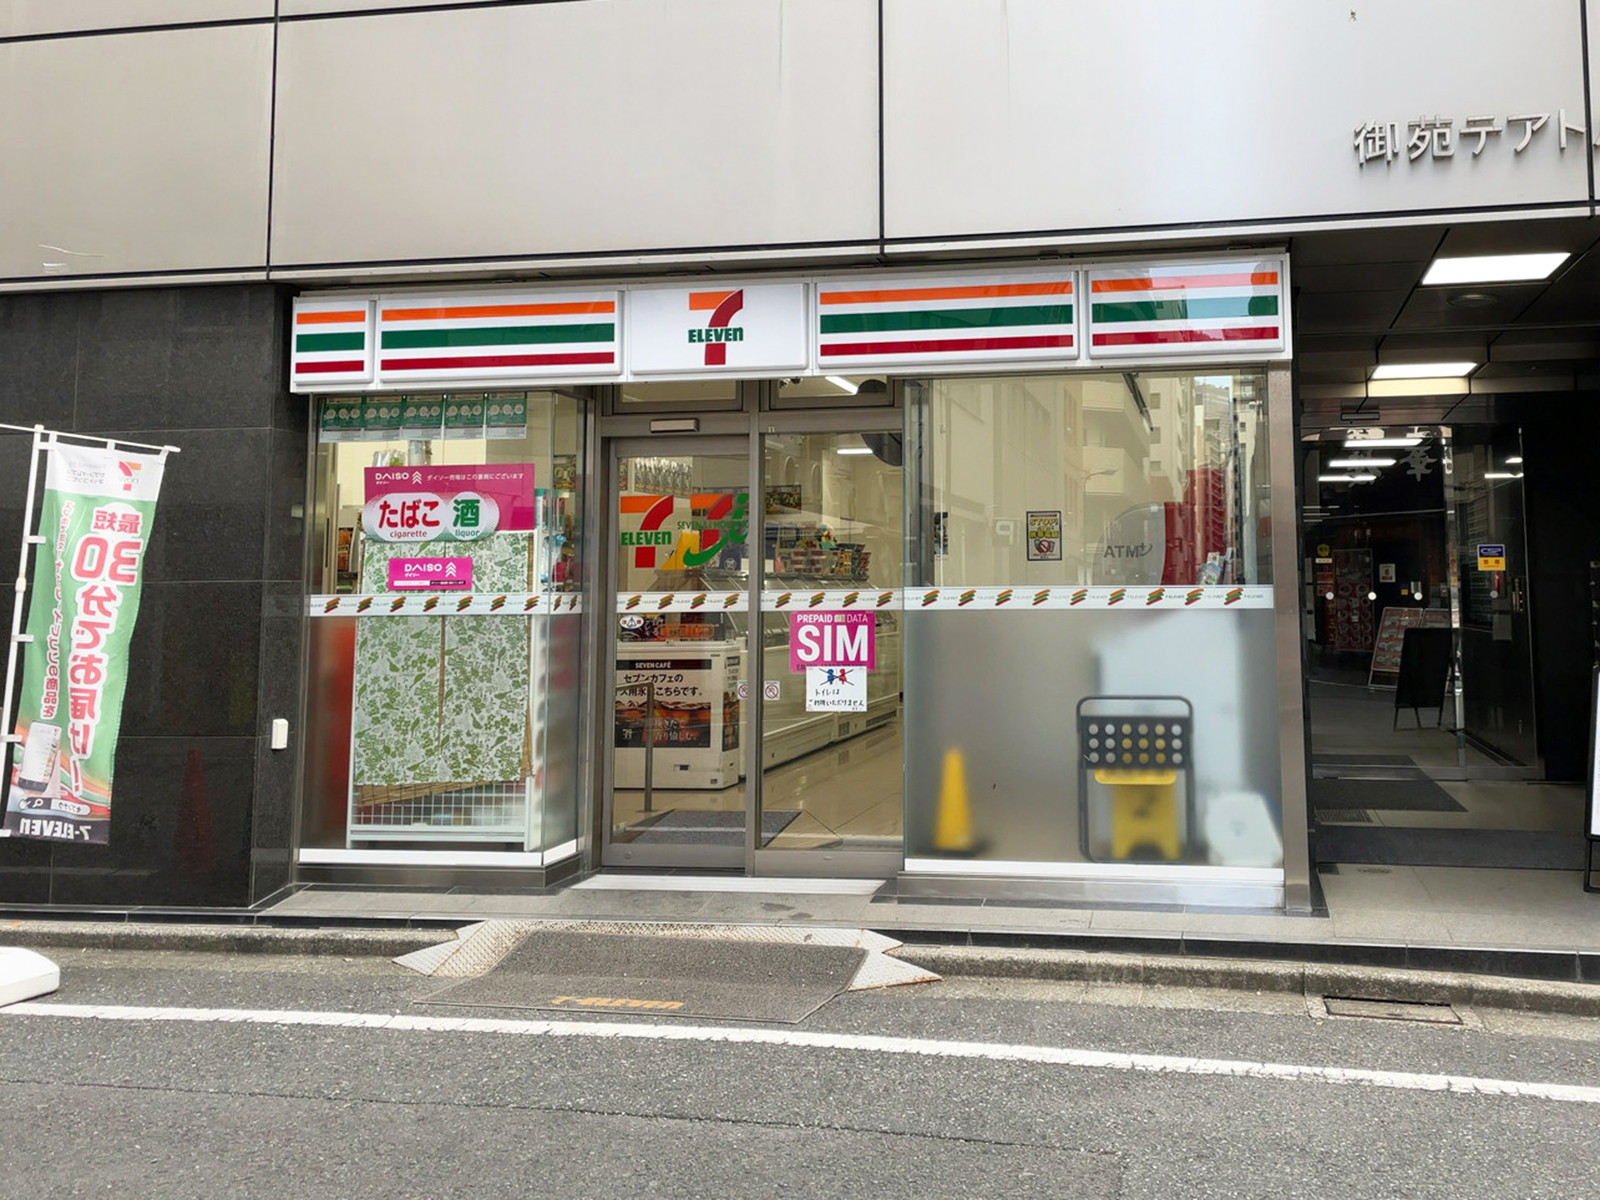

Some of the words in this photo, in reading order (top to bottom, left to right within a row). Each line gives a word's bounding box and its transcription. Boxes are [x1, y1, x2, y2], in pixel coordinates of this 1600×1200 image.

[1353, 109, 1600, 167] 御苑テアト
[688, 326, 744, 343] ELEVEN
[375, 472, 410, 481] DAISO
[378, 498, 441, 529] たばこ
[452, 498, 481, 528] 酒
[390, 530, 428, 538] cigarette
[455, 529, 480, 538] liquor
[621, 531, 672, 546] ELEVEN
[404, 563, 443, 572] DAISO
[796, 614, 833, 623] PREPAID
[846, 614, 869, 623] DATA
[796, 624, 869, 662] SIM
[623, 673, 684, 684] セブンカフェの
